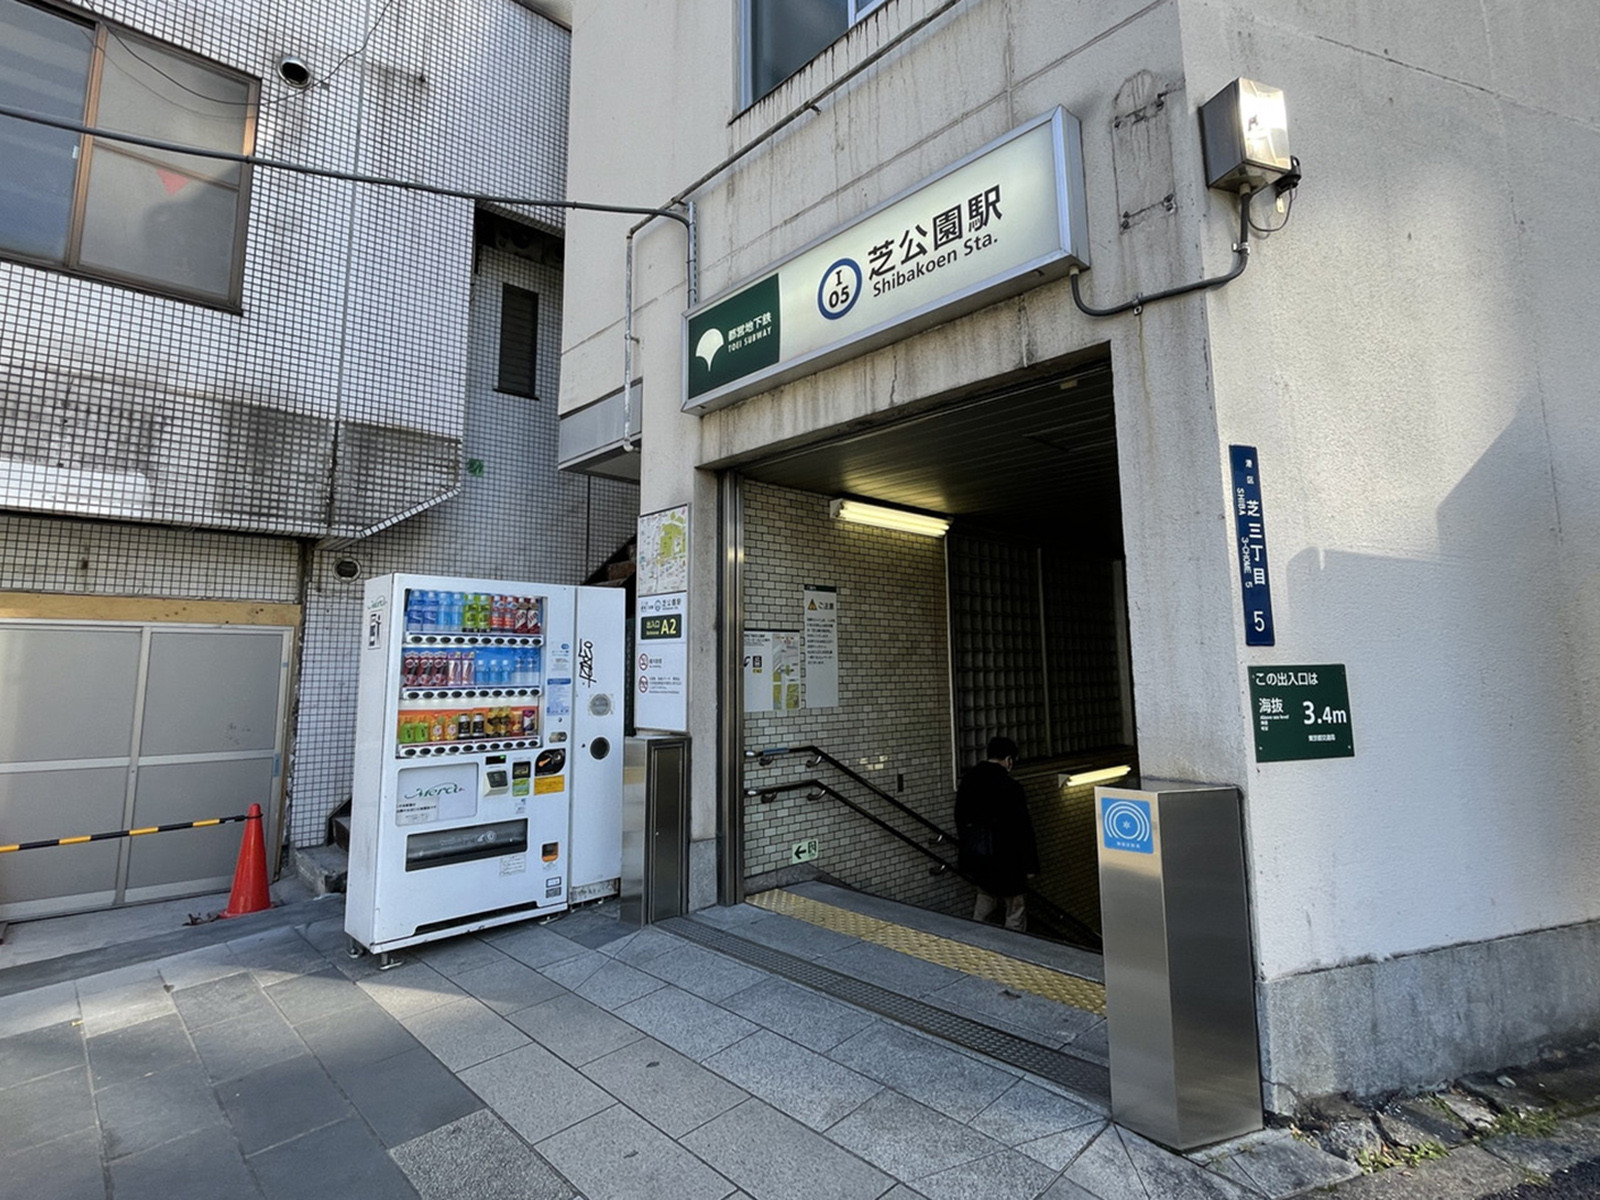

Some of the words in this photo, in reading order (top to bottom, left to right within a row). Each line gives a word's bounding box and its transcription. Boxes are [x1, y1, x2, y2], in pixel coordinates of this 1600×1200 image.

[868, 184, 1002, 280] 芝公園駅
[873, 250, 957, 297] Shibakoen
[964, 233, 998, 257] Sta.
[835, 270, 843, 286] I
[829, 286, 850, 309] 05
[728, 311, 772, 342] 都営地下鉄
[728, 340, 742, 352] TOEI
[743, 326, 772, 346] SUBWAY
[1237, 487, 1246, 516] SHIBA
[1246, 499, 1265, 585] 芝三丁目
[1241, 536, 1251, 574] 3-CHOME
[660, 618, 677, 635] A2
[1253, 611, 1265, 632] 5
[1255, 672, 1319, 686] この出入口は
[1259, 697, 1284, 714] 海抜
[1302, 700, 1347, 725] 3.4m
